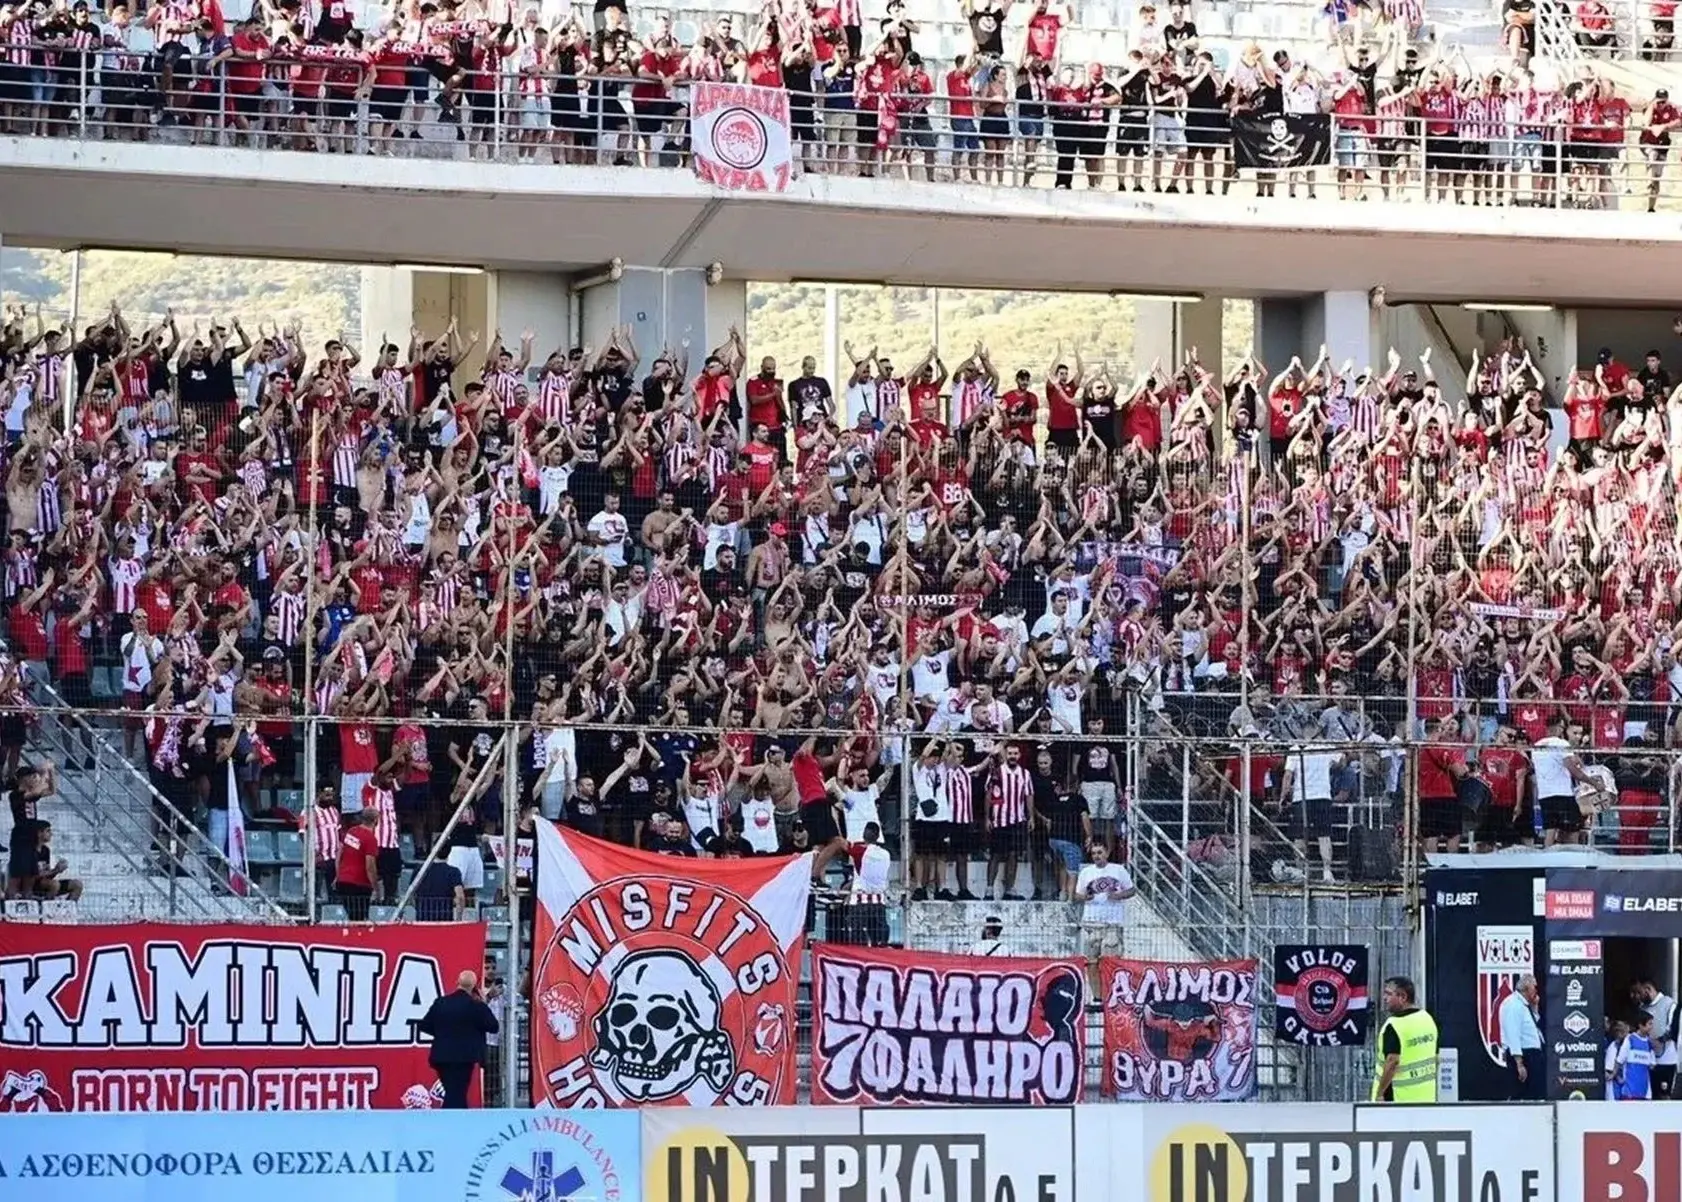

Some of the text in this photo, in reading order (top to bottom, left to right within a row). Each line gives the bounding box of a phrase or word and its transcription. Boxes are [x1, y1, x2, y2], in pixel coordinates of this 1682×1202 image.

[774, 161, 791, 192] 7
[1446, 892, 1479, 905] ELABET
[559, 881, 781, 995] MISFITS
[1479, 938, 1531, 963] VOLOS
[1285, 949, 1357, 974] VOLOS
[1561, 965, 1601, 974] ELABET
[0, 943, 443, 1044] KAMINIA
[823, 962, 1033, 1036] ΠΑΛΑΙΟ
[1108, 966, 1254, 1009] ΑΛΙΜΟΣ
[1284, 1016, 1359, 1046] GATE 7
[1566, 1041, 1598, 1052] volton
[1112, 1047, 1253, 1096] ΘΥΡΑ 7
[73, 1070, 376, 1110] BORN TO FIGHT
[18, 1152, 243, 1178] ΑΣΘΕΝΟΦΟΡΑ
[252, 1150, 435, 1176] ΘΕΣΣΑΛΙΑΣ
